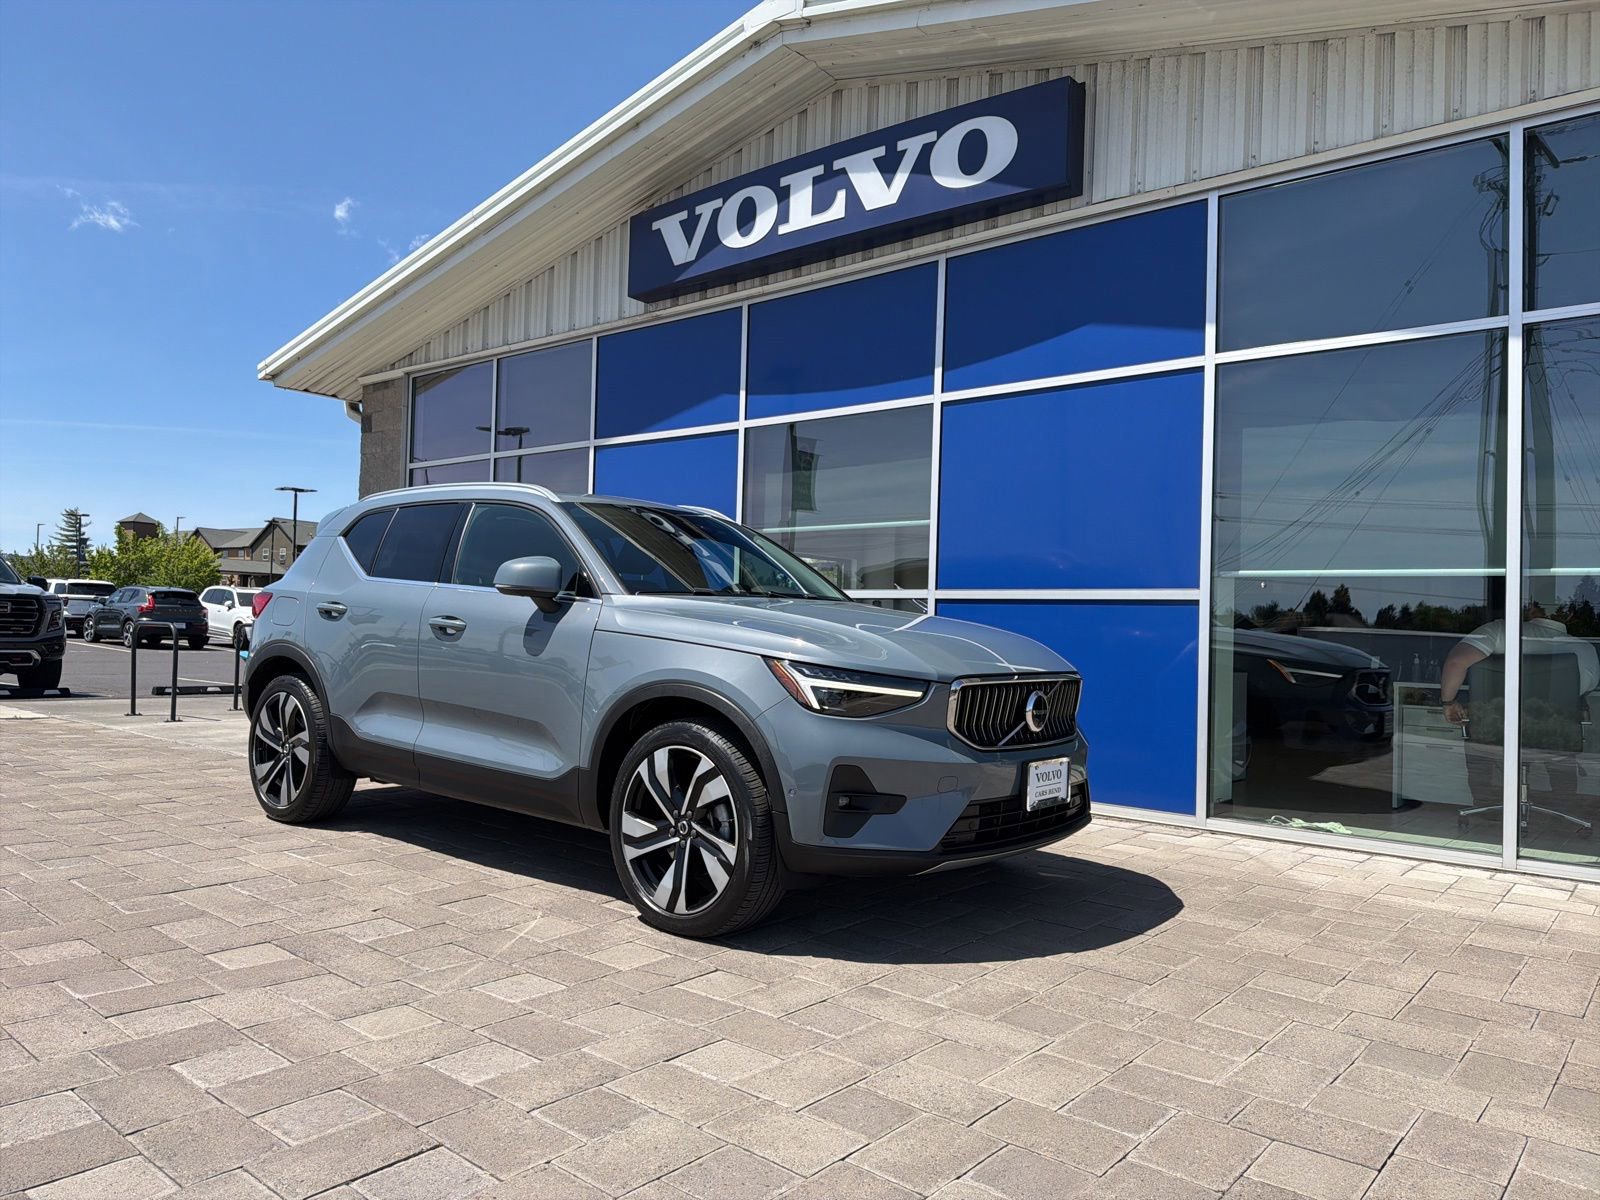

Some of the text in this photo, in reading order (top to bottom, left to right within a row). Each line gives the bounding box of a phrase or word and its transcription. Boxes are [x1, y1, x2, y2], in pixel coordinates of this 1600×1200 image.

[652, 115, 1018, 266] VOLVO
[1035, 769, 1062, 783] VOLVO
[1034, 790, 1048, 798] CARS
